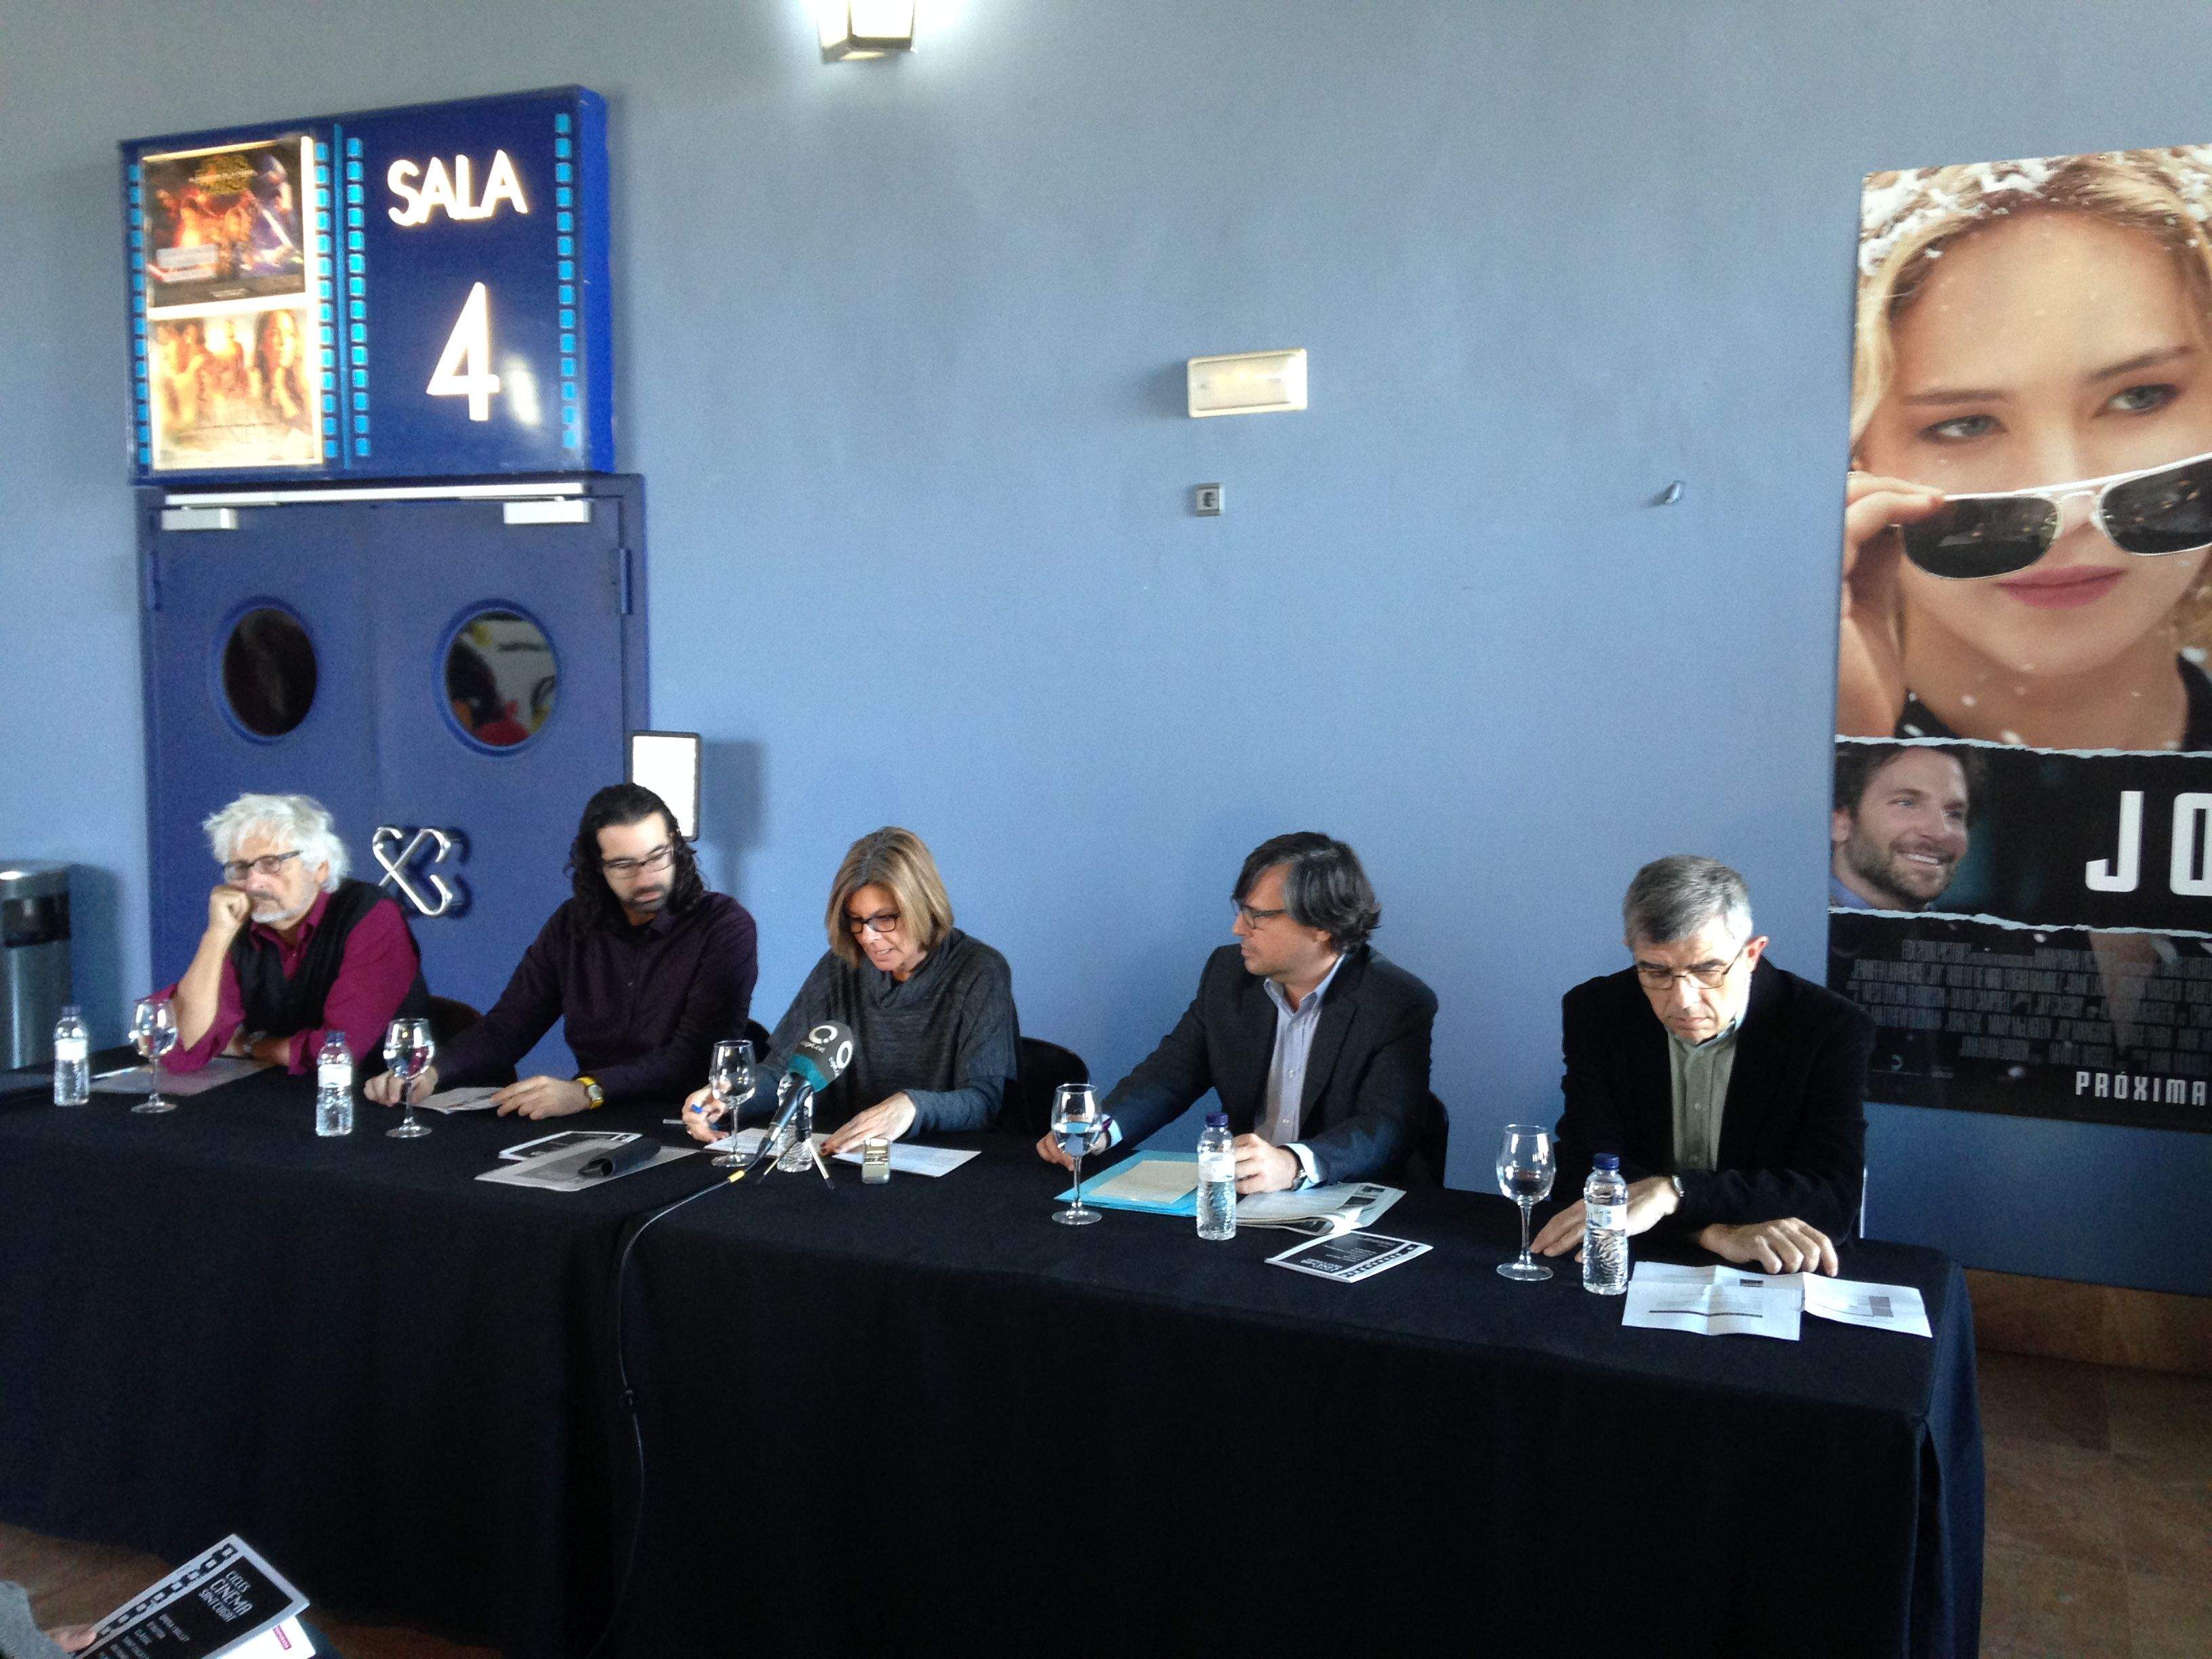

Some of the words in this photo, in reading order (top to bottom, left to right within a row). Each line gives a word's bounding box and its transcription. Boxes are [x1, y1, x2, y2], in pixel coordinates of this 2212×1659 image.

[387, 149, 529, 226] SALA
[426, 282, 500, 421] 4
[2085, 790, 2212, 896] JO
[2075, 1071, 2207, 1106] PRÓXIMA
[209, 1578, 253, 1616] CINEMA
[225, 1570, 251, 1593] CICLES
